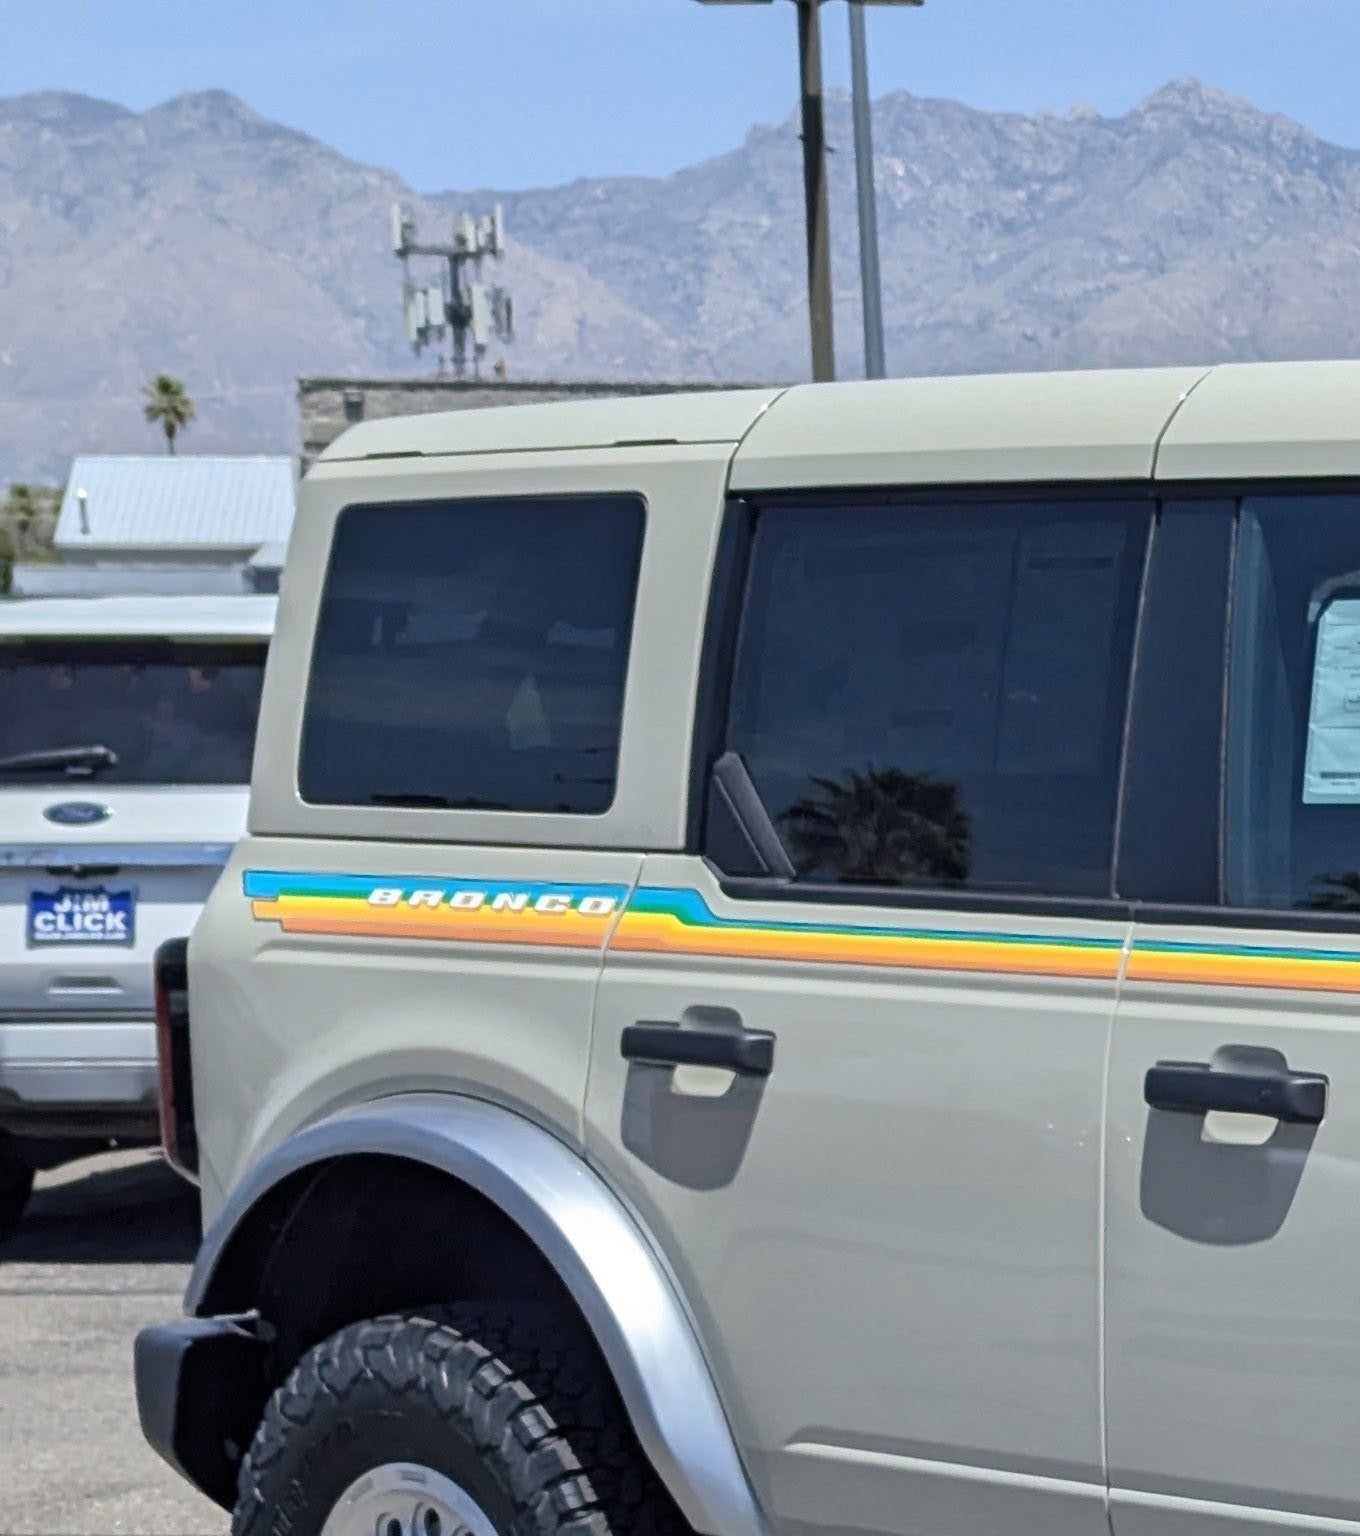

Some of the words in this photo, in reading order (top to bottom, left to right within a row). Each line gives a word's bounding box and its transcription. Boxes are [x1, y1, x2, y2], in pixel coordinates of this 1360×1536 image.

[54, 894, 110, 912] JIM
[368, 887, 617, 916] BRONCO
[34, 911, 127, 932] CLICK
